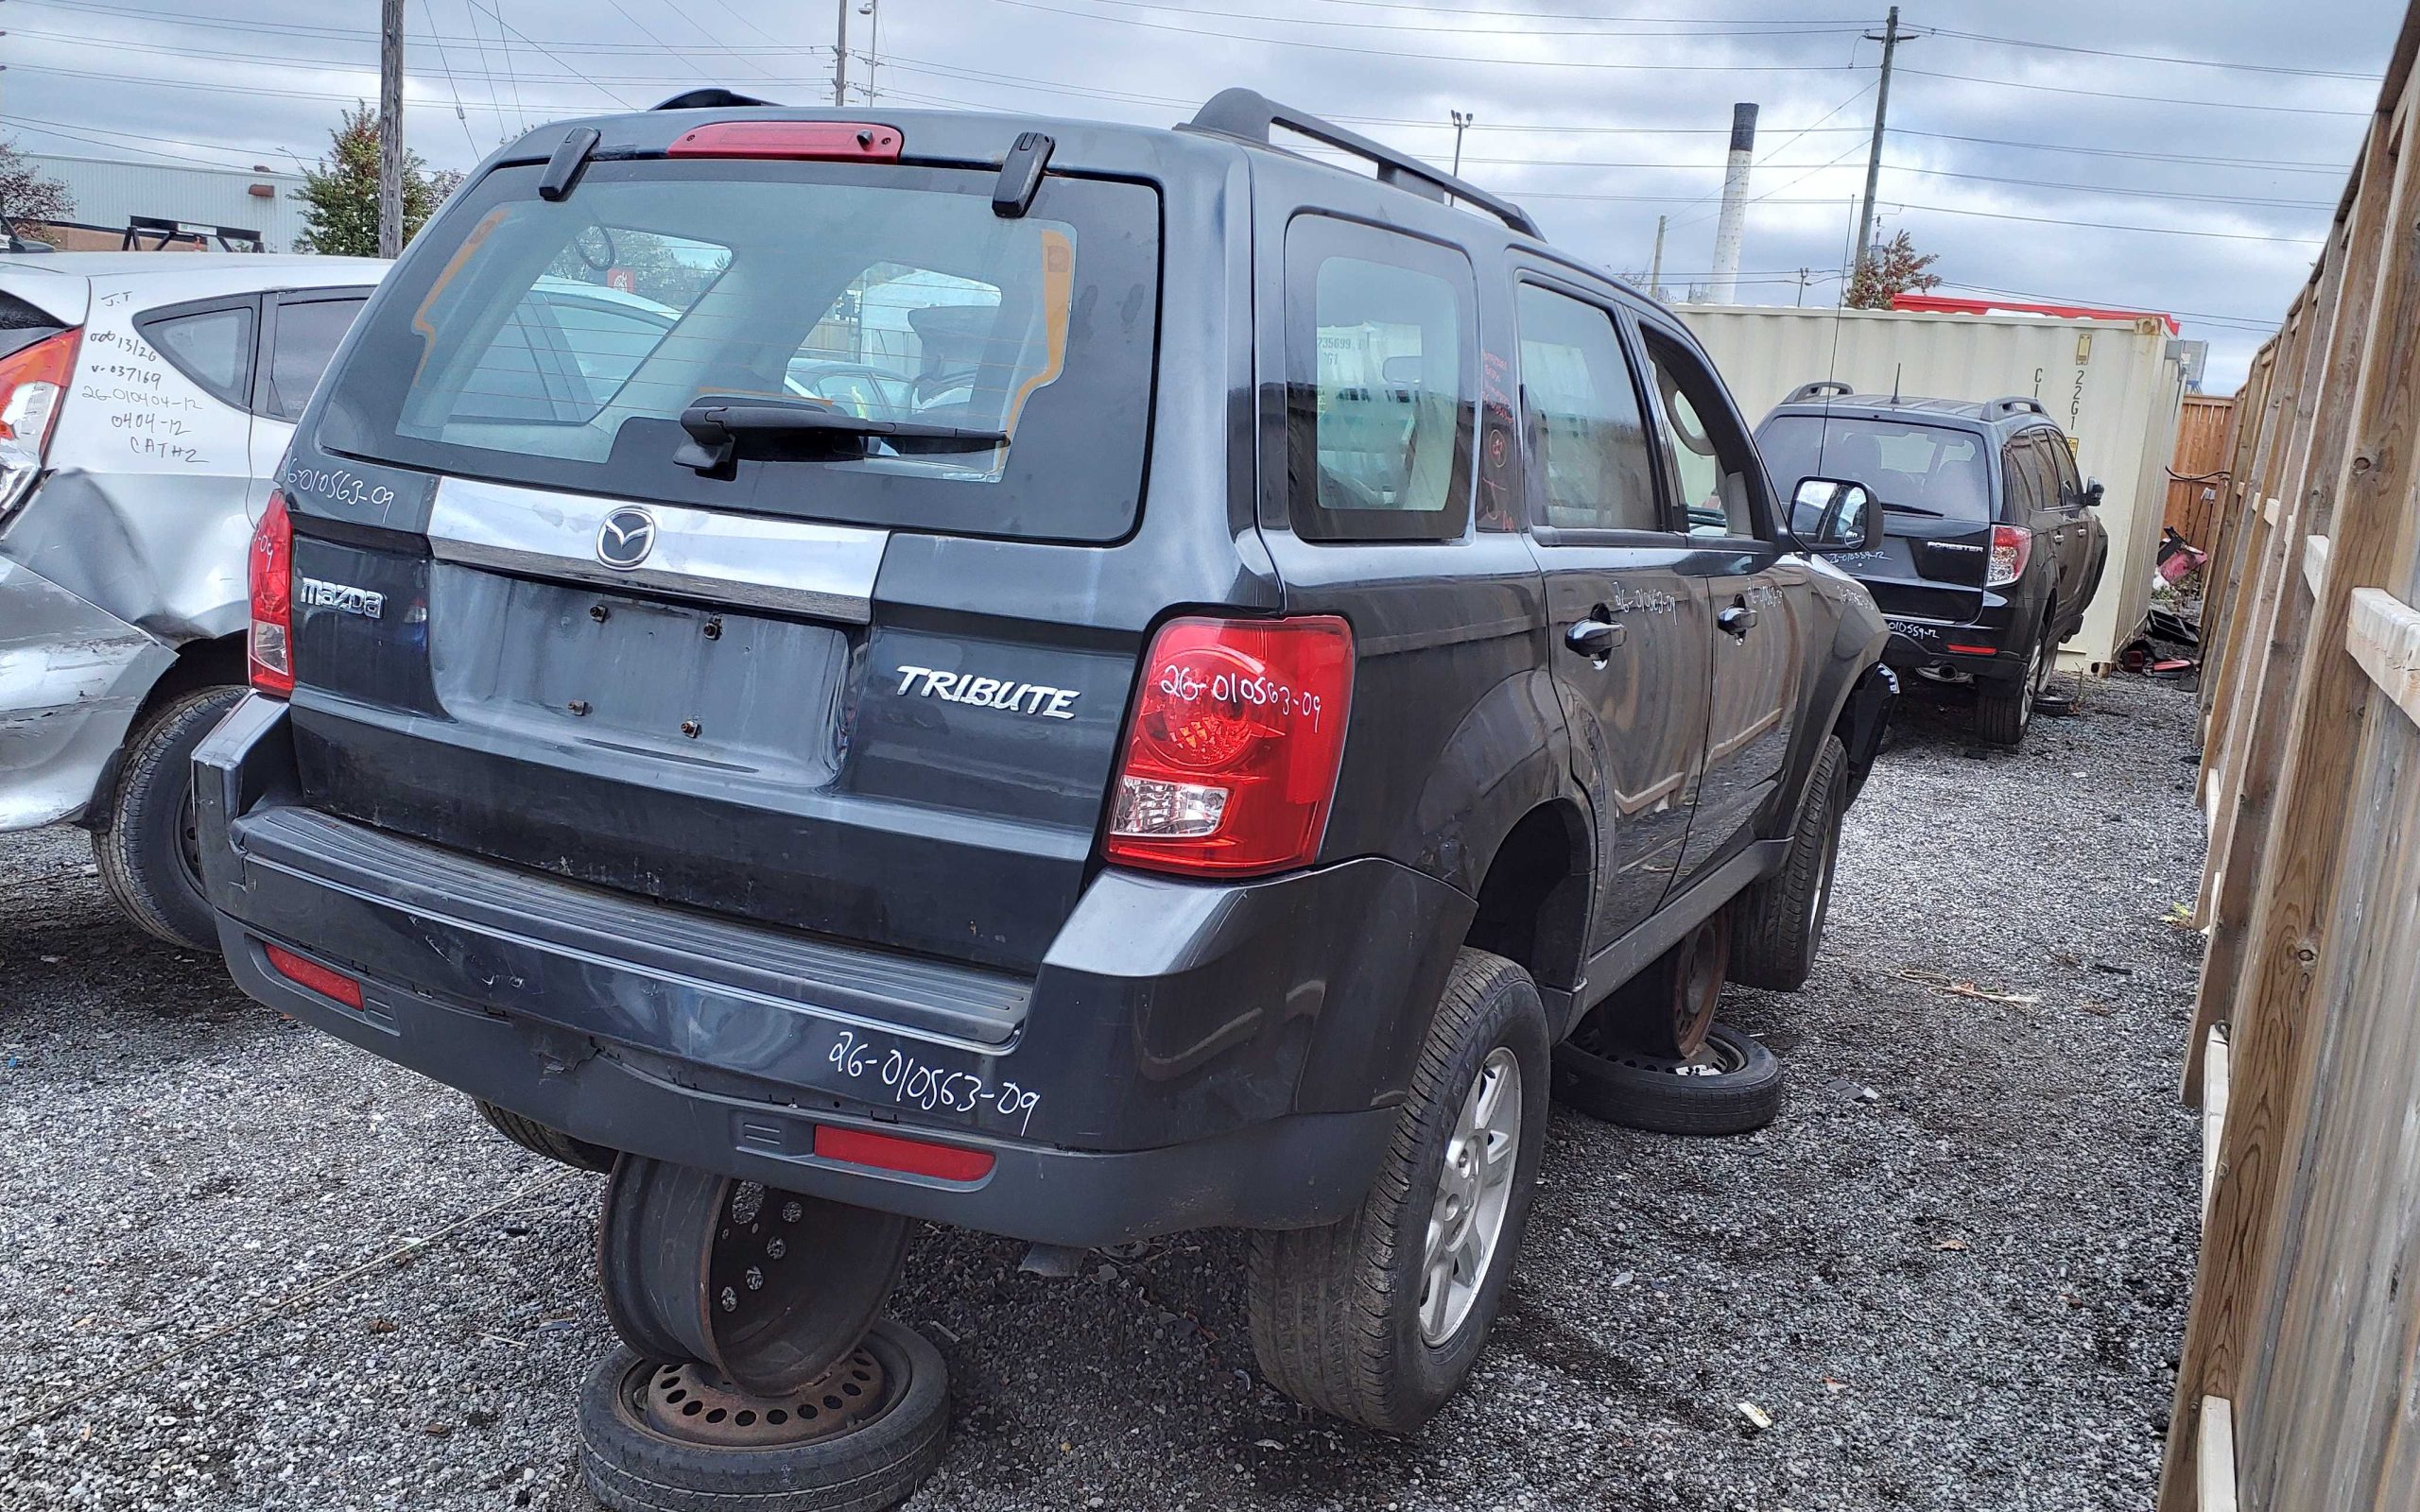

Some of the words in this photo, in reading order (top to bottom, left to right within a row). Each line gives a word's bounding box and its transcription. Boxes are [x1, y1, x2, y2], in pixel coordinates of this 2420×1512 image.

[1927, 541, 1984, 553] FORESTER
[896, 665, 1081, 720] TRIBUTE
[828, 1031, 1041, 1137] 26-010563-09
